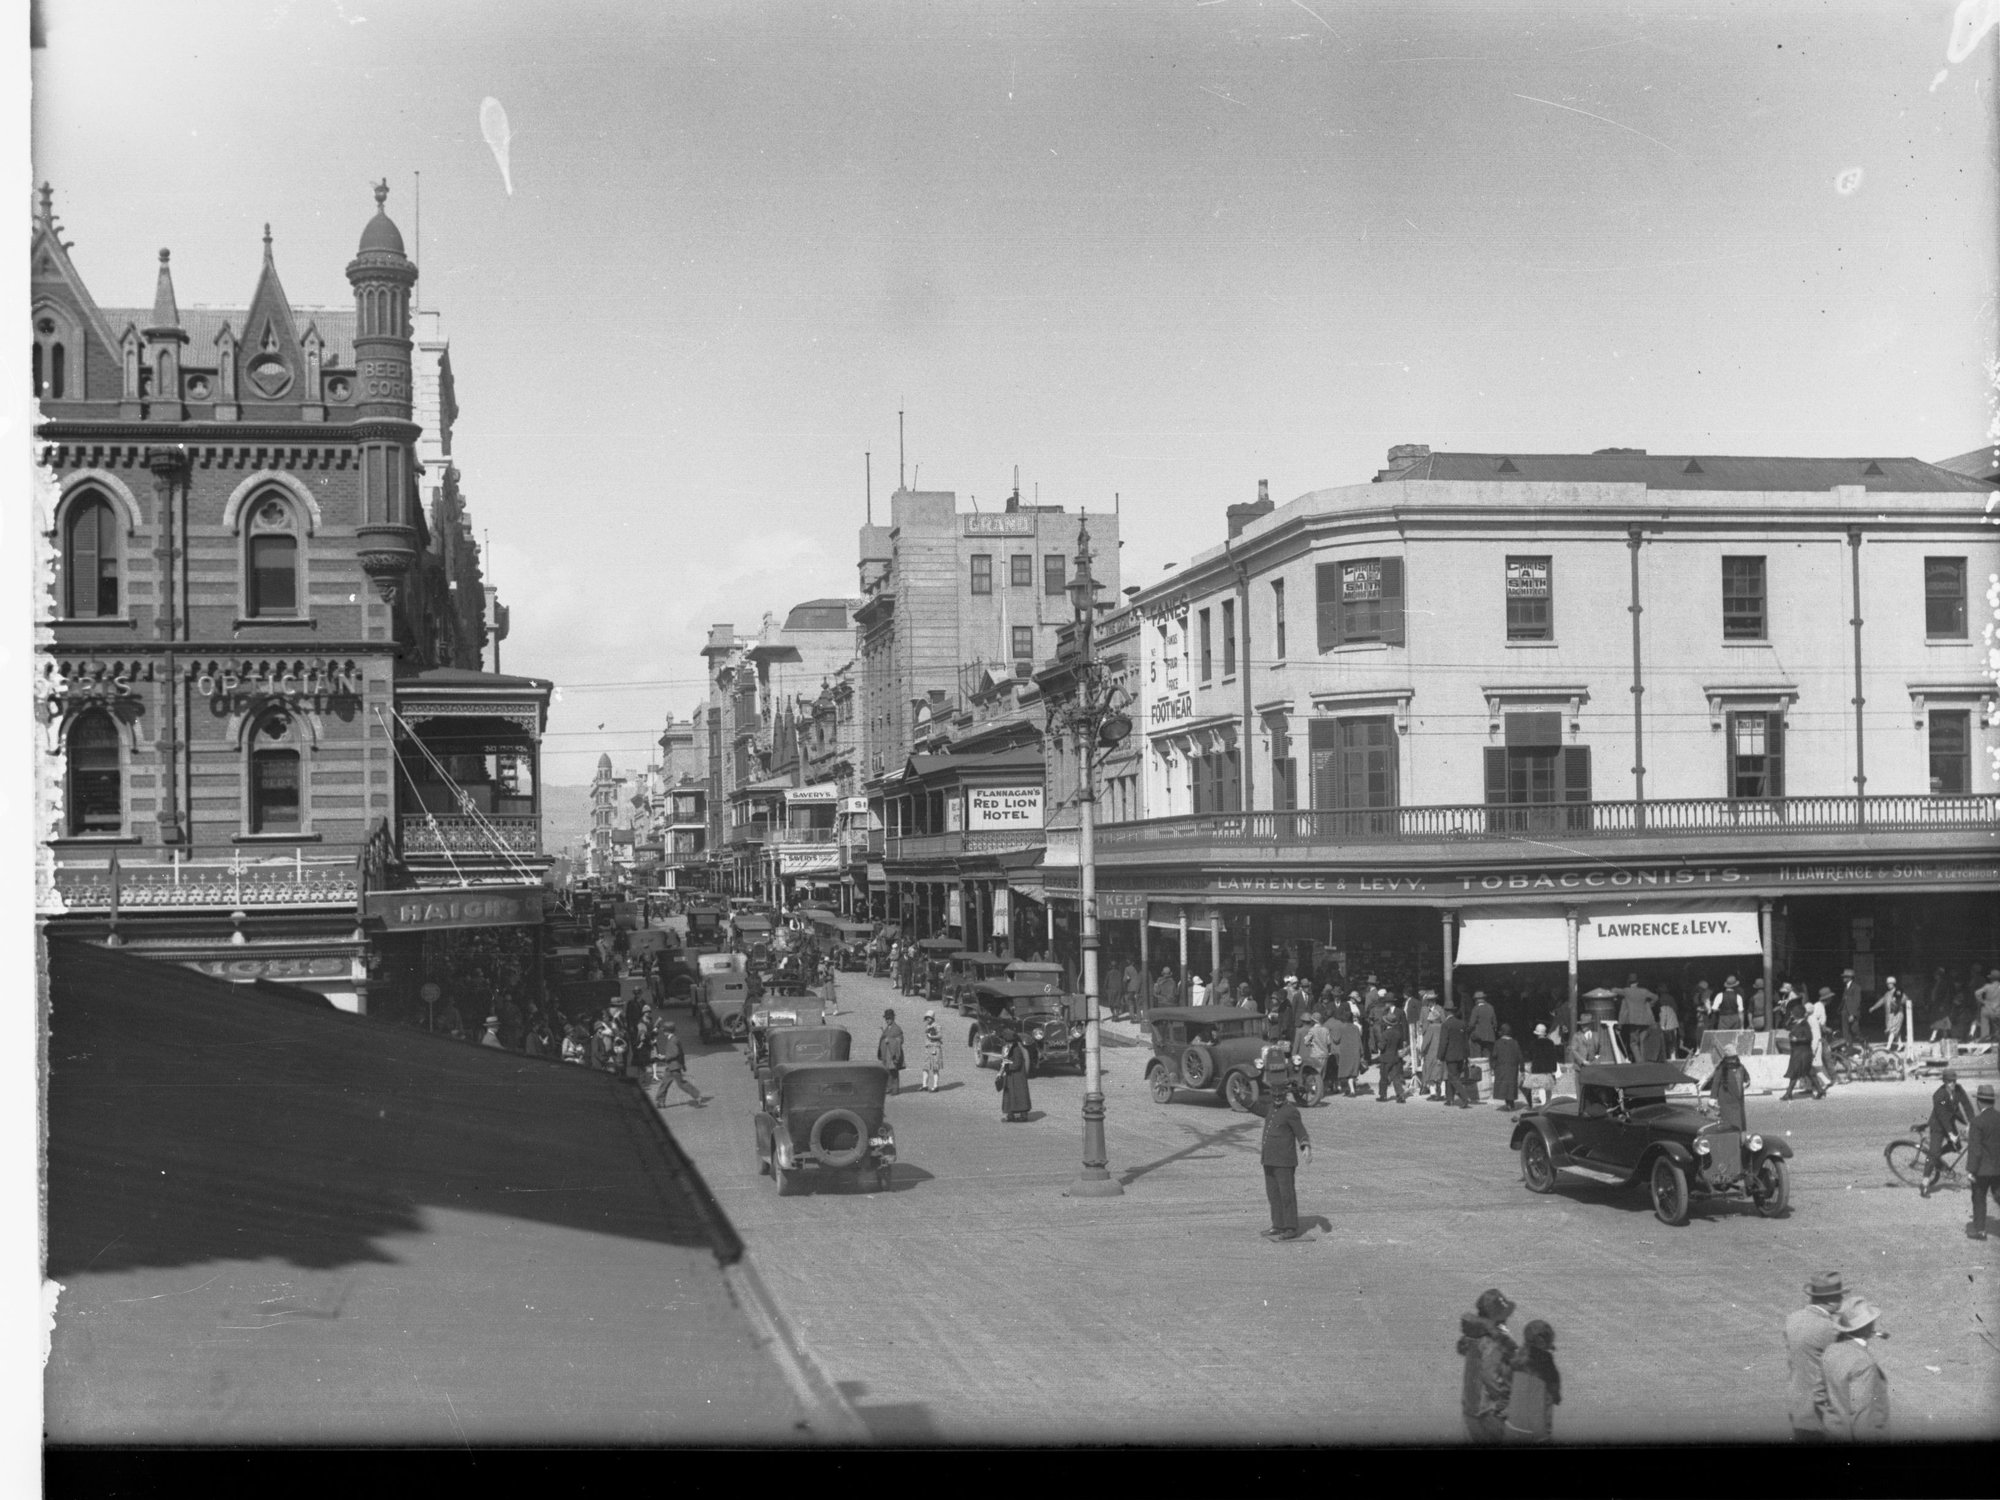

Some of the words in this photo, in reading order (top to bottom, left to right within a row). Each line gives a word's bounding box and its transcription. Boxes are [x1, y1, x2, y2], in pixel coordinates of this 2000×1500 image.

[968, 515, 1028, 532] GRAND
[1356, 572, 1366, 581] A
[1521, 569, 1531, 577] A
[1150, 660, 1157, 684] 5
[197, 674, 356, 697] OPTICIAN
[1151, 695, 1192, 726] FOOTWEAR
[976, 788, 1041, 797] FLANNAGAN'S
[973, 798, 999, 809] RED
[1004, 798, 1037, 808] LION
[983, 810, 1029, 820] HOTEL
[1456, 867, 1750, 890] TOBACCONISTS.
[1877, 868, 1890, 879] &
[1217, 876, 1326, 890] LAWRENCE
[1336, 878, 1347, 891] &
[1359, 876, 1426, 891] LEVY.
[1106, 894, 1143, 906] KEEP
[1113, 907, 1146, 918] LEFT
[1597, 921, 1680, 938] LAWRENCE
[1682, 925, 1690, 935] &
[1691, 918, 1732, 935] LEVY.
